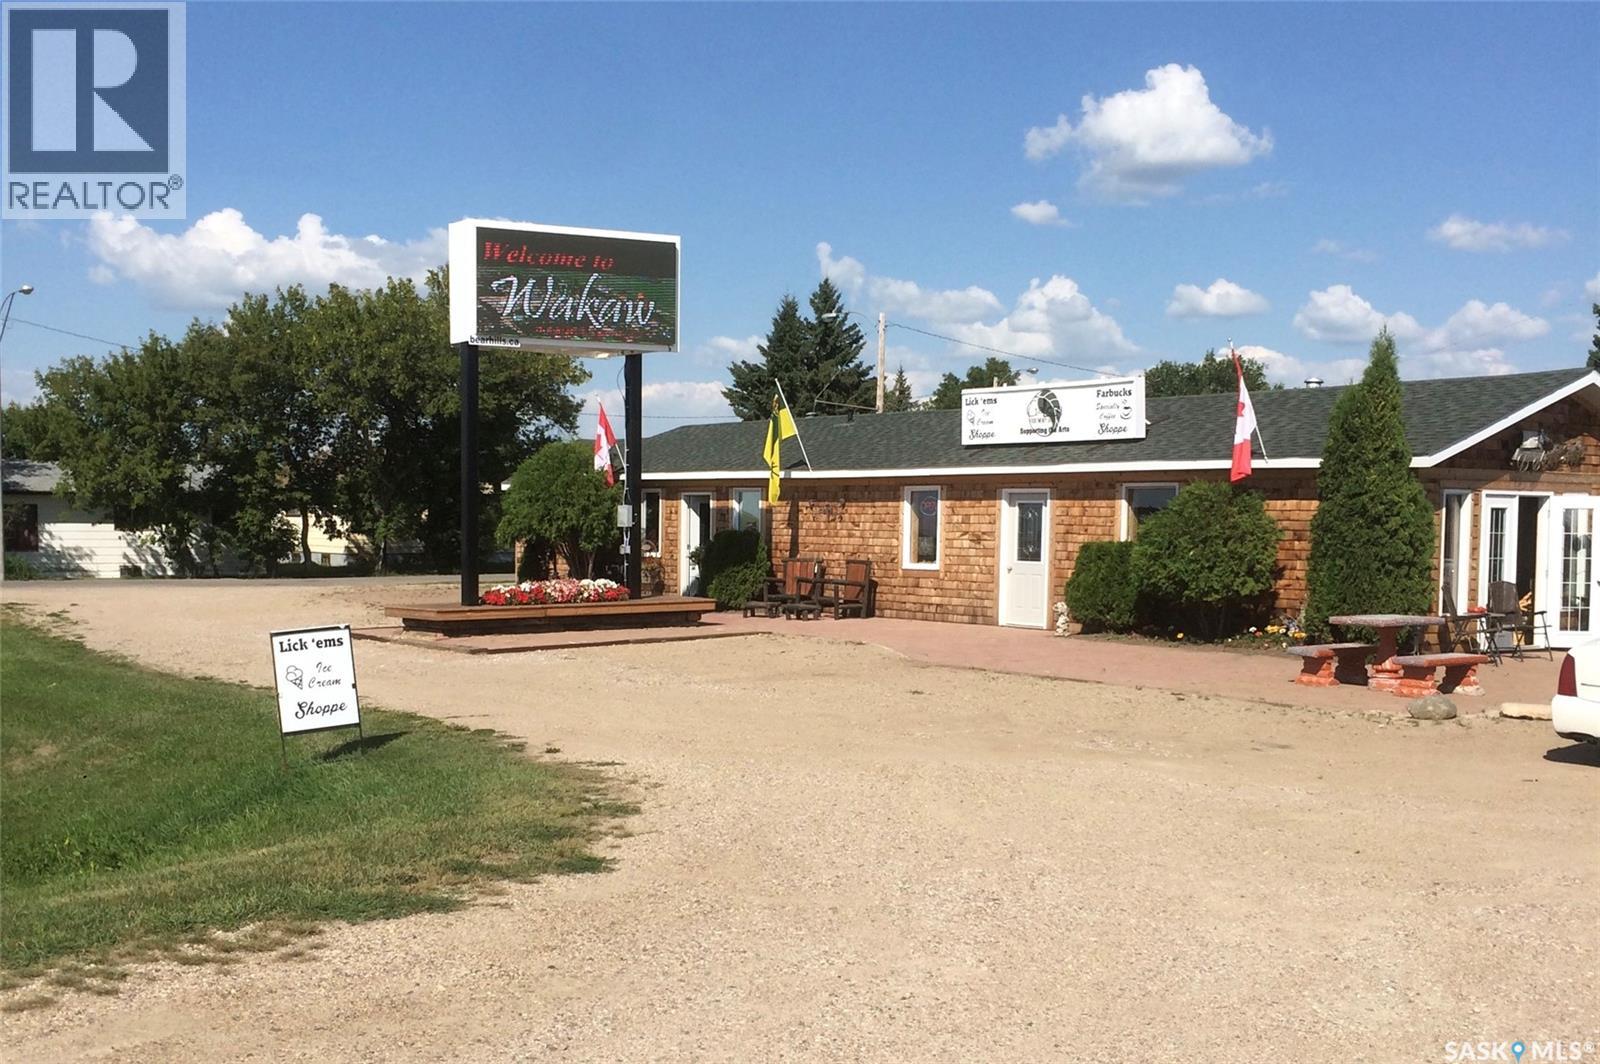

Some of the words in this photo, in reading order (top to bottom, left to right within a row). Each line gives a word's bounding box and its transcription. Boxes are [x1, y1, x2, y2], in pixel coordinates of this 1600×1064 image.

[483, 239, 587, 269] Welcome
[592, 255, 615, 271] to
[490, 272, 656, 329] Wakaw
[1096, 387, 1132, 398] Farbucks
[965, 397, 979, 406] Lick
[969, 429, 995, 440] Shoppe
[1020, 427, 1048, 435] Supporting
[1098, 422, 1127, 435] Shoppe
[279, 638, 308, 653] Lick
[316, 662, 332, 673] Ice
[308, 676, 341, 689] Cream
[295, 701, 347, 720] Shoppe
